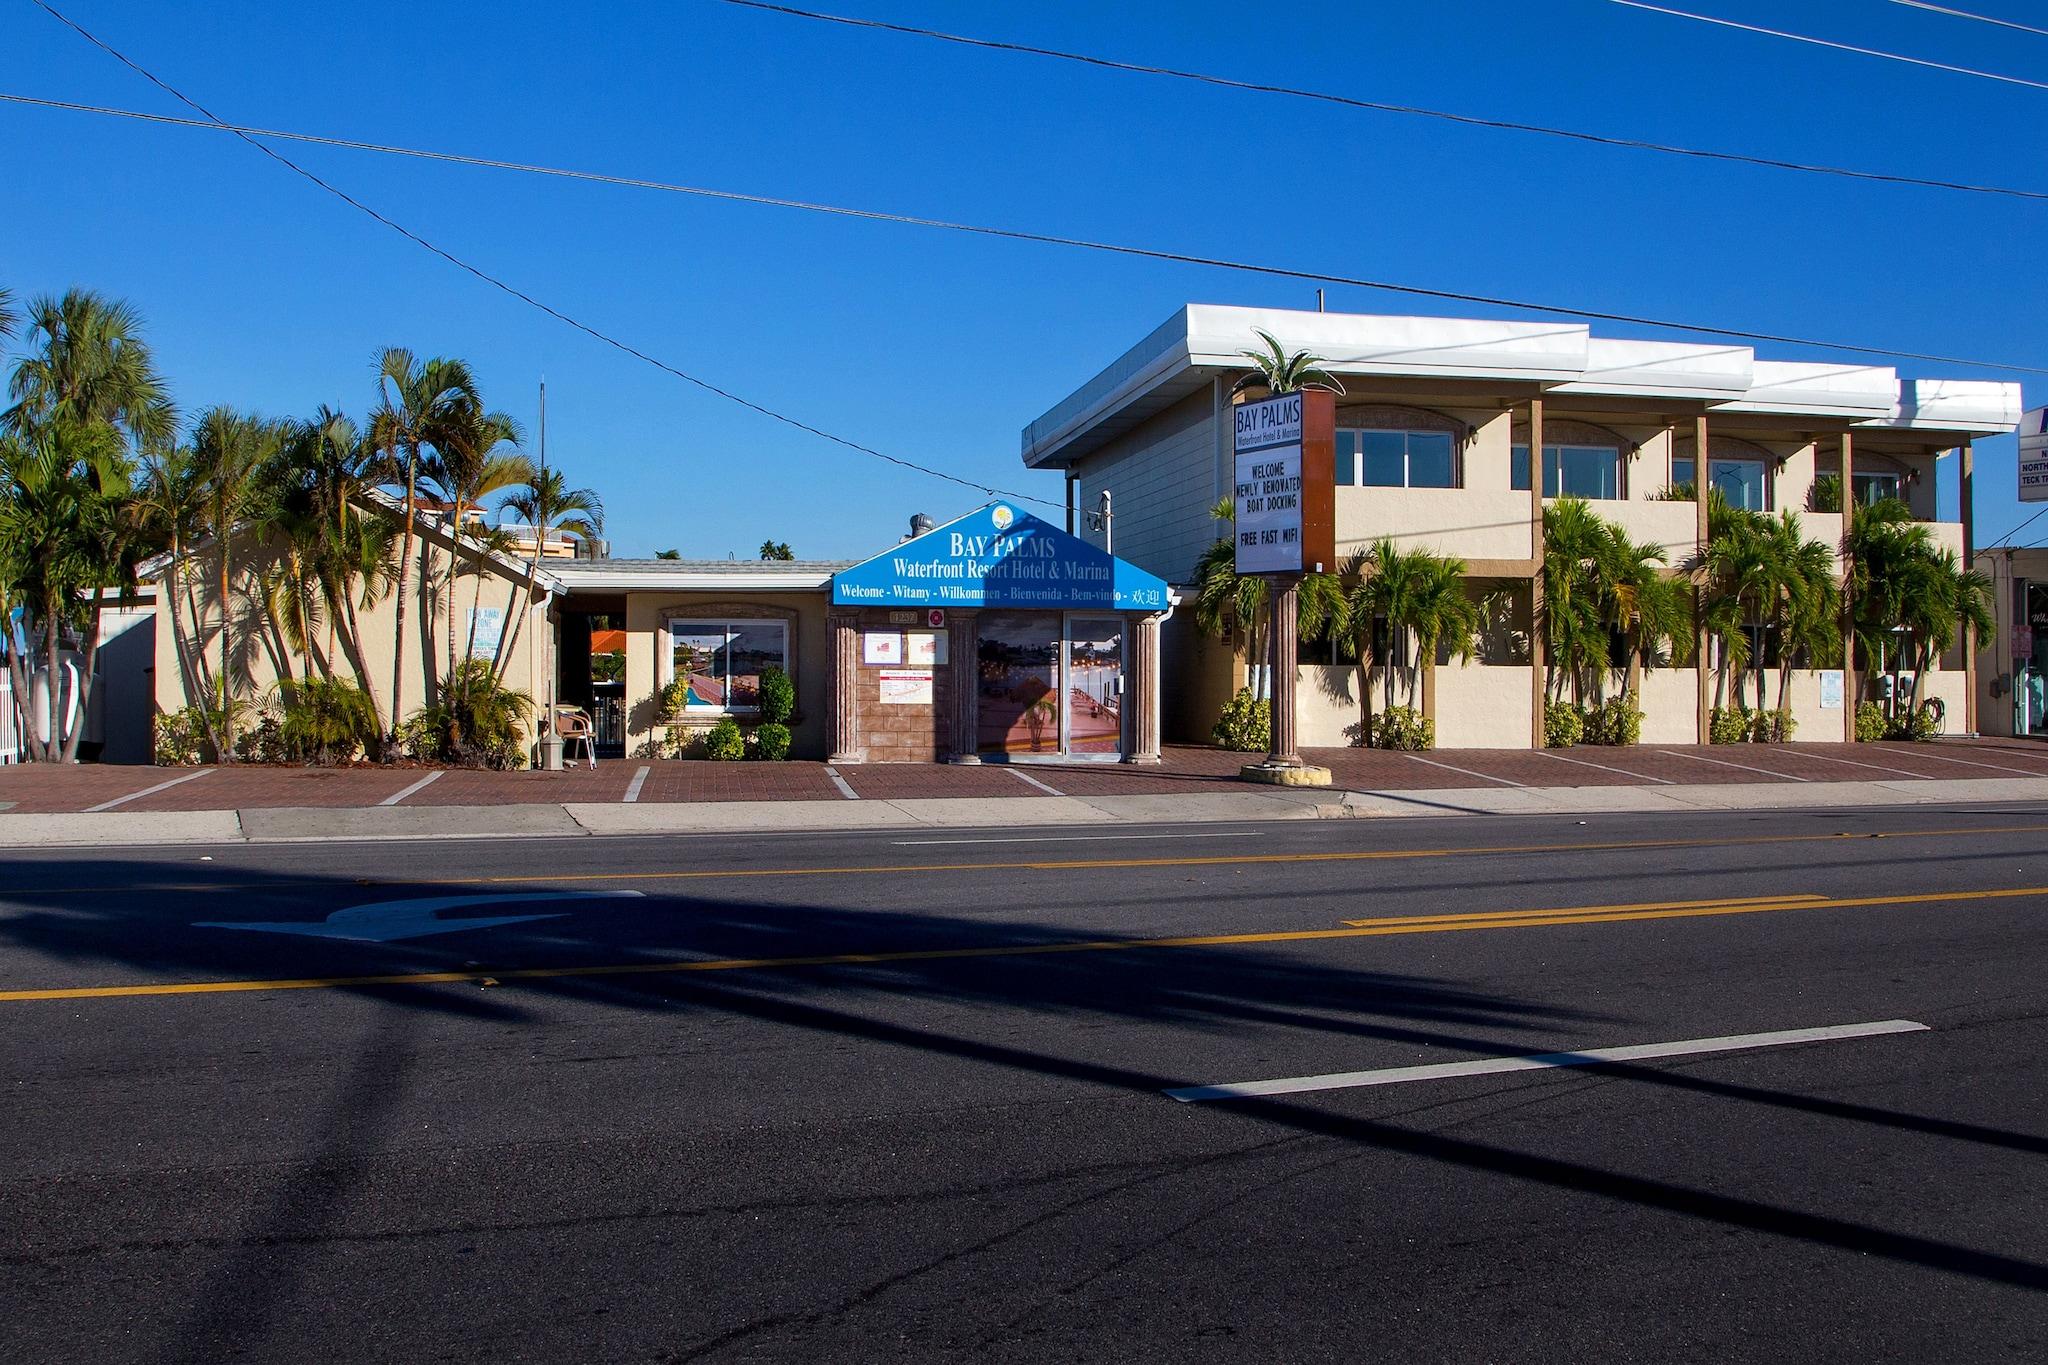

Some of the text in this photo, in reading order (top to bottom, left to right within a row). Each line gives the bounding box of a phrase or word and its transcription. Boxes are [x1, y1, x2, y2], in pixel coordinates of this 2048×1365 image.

[1237, 399, 1300, 433] BAY PALMS
[1237, 427, 1300, 446] Waterfront Hotel & Marina
[1252, 462, 1285, 479] WELCOME
[2022, 475, 2039, 485] TECK
[1236, 476, 1302, 498] NEWLY RENOVATED
[1246, 494, 1297, 513] BOAT DOCKING
[950, 532, 1055, 558] BAY PALMS
[1240, 527, 1298, 546] FREE FAST WIFI
[893, 558, 1110, 581] Waterfront Resort Hotel & Marina
[840, 583, 885, 598] Welcome
[893, 585, 930, 602] Witamy
[939, 586, 1001, 600] Willkommen
[1010, 586, 1062, 601] Bienvenida
[1071, 588, 1121, 601] Bem-vindo
[1132, 589, 1161, 606] 欢迎
